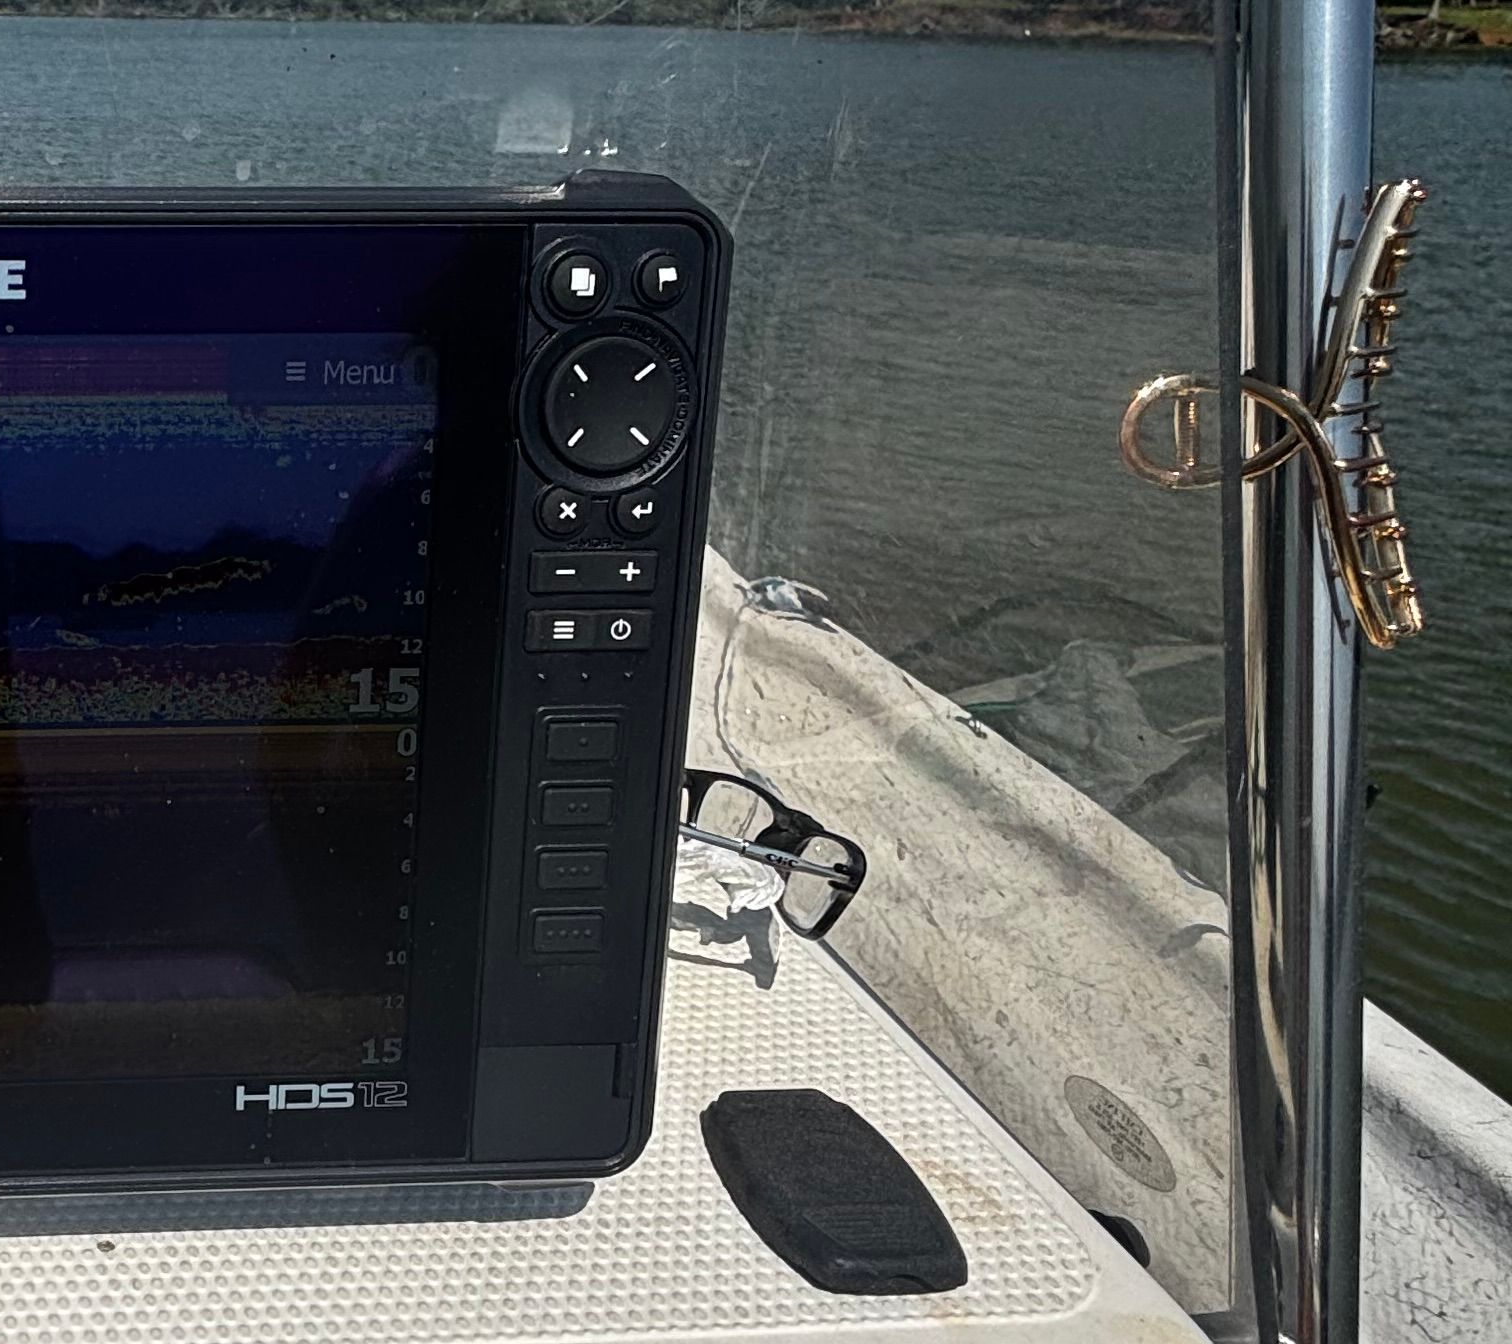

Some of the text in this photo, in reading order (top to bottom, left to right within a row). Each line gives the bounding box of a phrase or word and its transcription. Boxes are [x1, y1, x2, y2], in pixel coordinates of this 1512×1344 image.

[322, 359, 395, 385] Menu
[423, 438, 435, 454] 4
[420, 489, 432, 505] 6
[417, 539, 429, 556] 8
[402, 589, 426, 606] 10
[400, 639, 424, 655] 12
[348, 666, 420, 713] 15
[397, 728, 418, 756] 0
[405, 767, 417, 782] 2
[402, 812, 414, 828] 4
[400, 858, 411, 874] 6
[399, 905, 409, 920] 8
[385, 950, 407, 965] 10
[383, 994, 405, 1009] 12
[360, 1037, 403, 1065] 15
